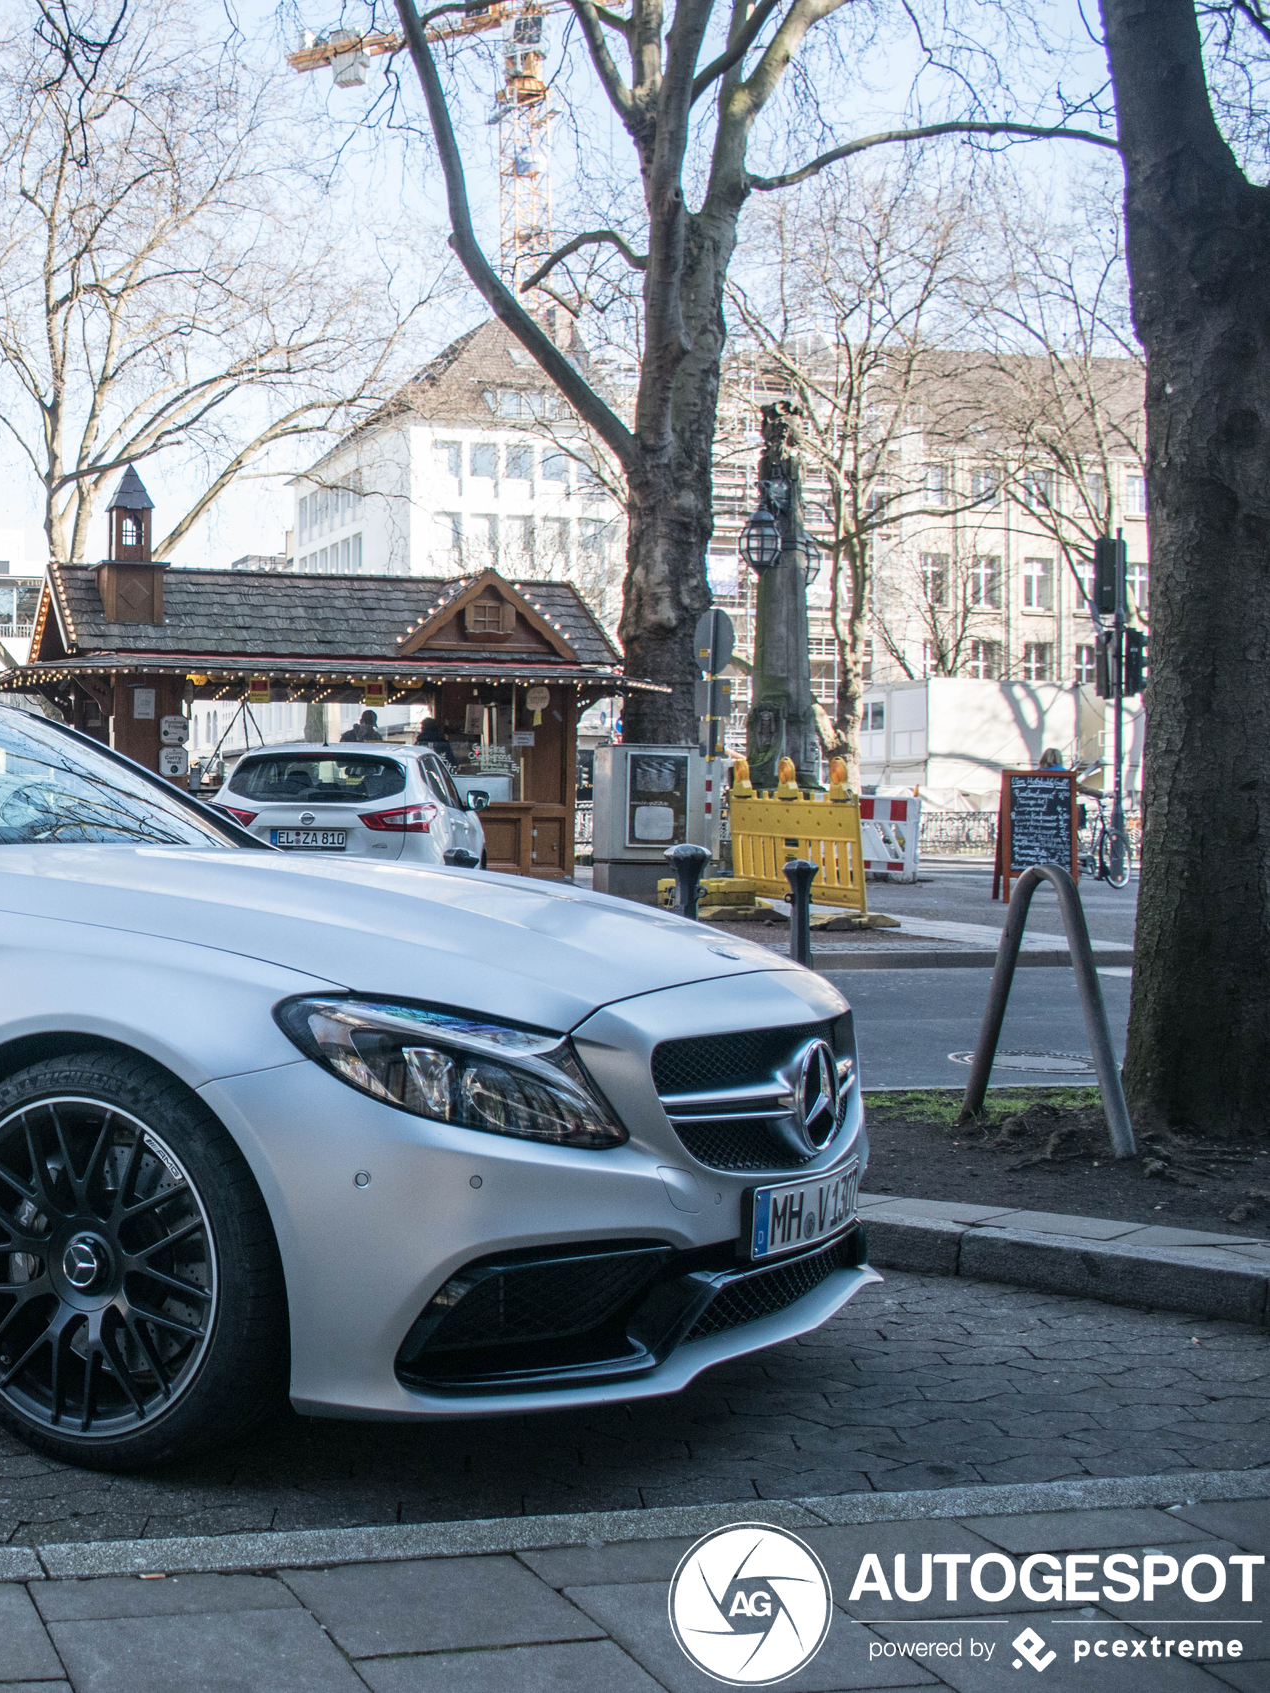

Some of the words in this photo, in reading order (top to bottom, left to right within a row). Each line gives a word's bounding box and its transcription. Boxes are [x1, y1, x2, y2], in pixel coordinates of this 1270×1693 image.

[278, 832, 294, 844] EL
[302, 832, 318, 845] ZA
[321, 833, 345, 845] 810
[36, 1070, 125, 1095] MICHELIN
[156, 1149, 180, 1178] AMG
[770, 1189, 805, 1247] MH
